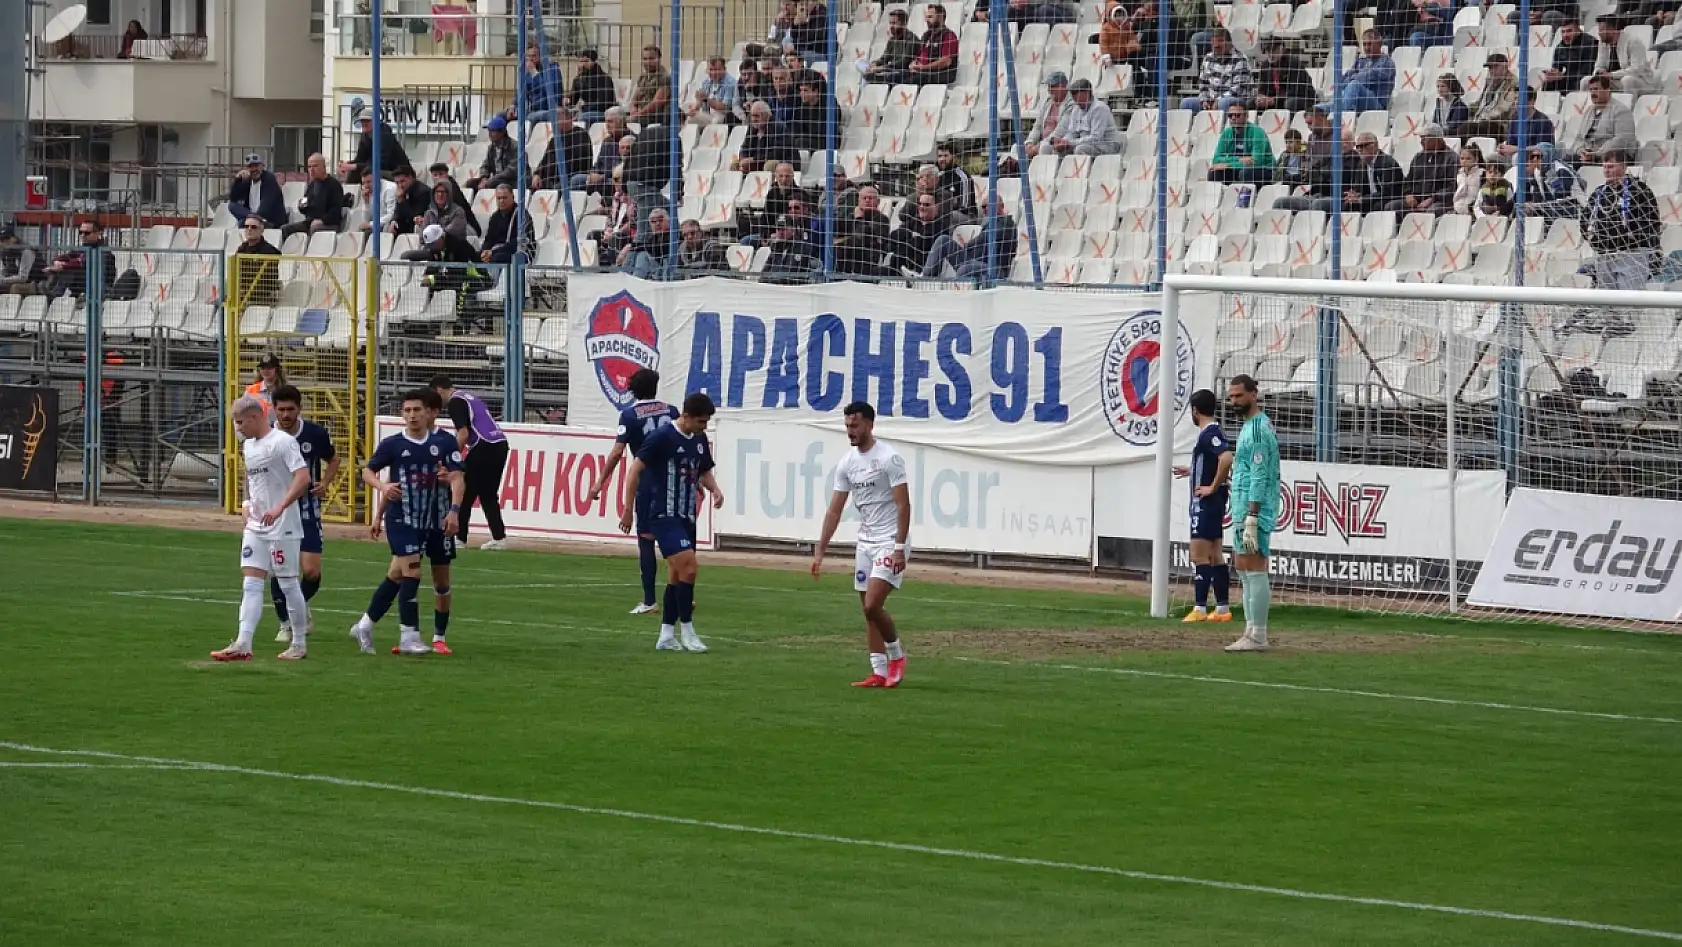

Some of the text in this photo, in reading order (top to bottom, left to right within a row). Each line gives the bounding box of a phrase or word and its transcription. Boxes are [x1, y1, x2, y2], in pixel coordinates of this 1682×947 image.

[1131, 319, 1161, 339] SPO
[685, 312, 1069, 423] APACHES 91
[1001, 507, 1088, 539] İNŞAAT
[272, 549, 285, 565] 15
[1268, 555, 1299, 576] ERA
[1304, 557, 1421, 583] MALZEMELERİ
[1562, 579, 1635, 593] GROUP
